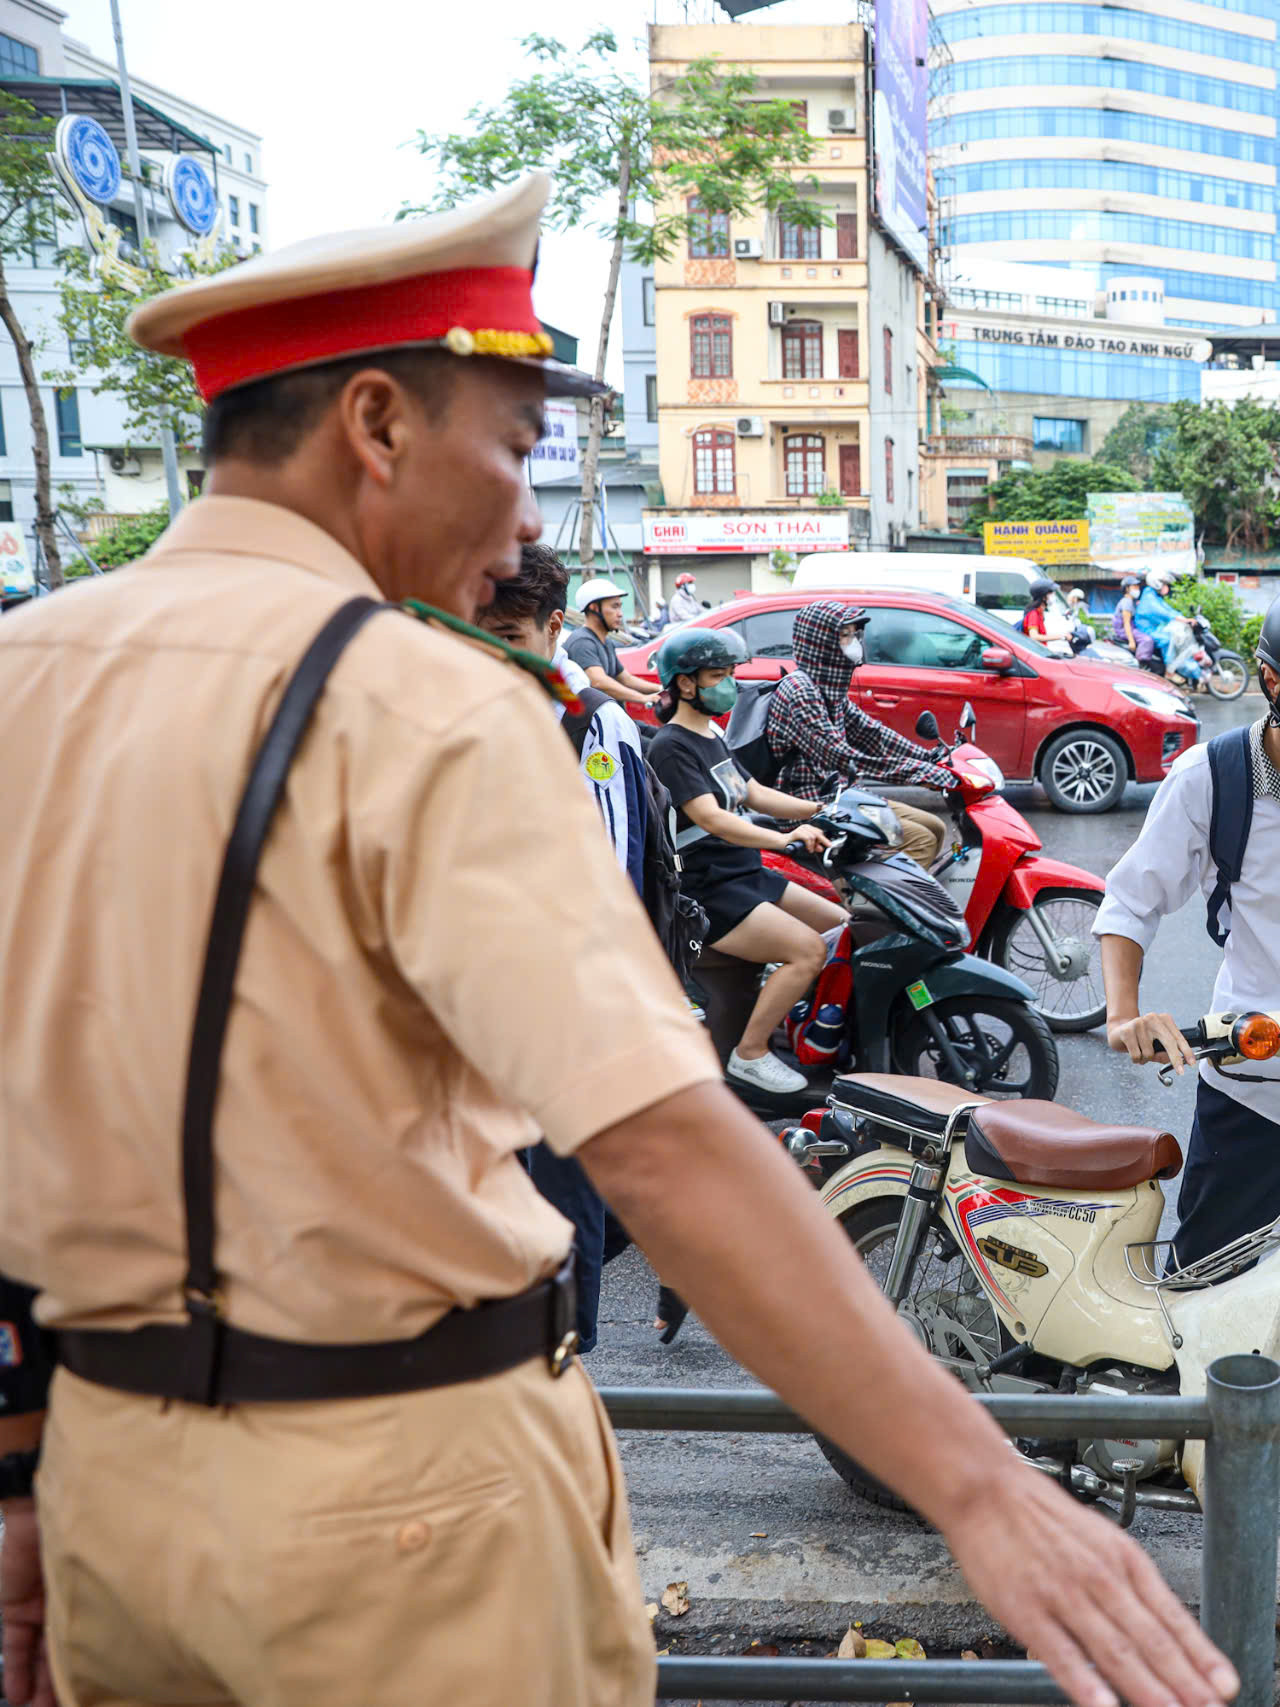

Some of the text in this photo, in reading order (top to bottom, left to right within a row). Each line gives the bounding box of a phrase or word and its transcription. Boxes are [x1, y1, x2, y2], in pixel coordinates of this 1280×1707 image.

[972, 327, 1024, 343] TRUNG
[1029, 329, 1058, 346] TÂM
[1064, 332, 1095, 349] ĐÀO
[1130, 342, 1159, 356] ANH
[722, 521, 767, 535] SƠN
[860, 961, 893, 970] HONDA
[1069, 1205, 1097, 1224] CC50
[977, 1238, 1049, 1278] CUB
